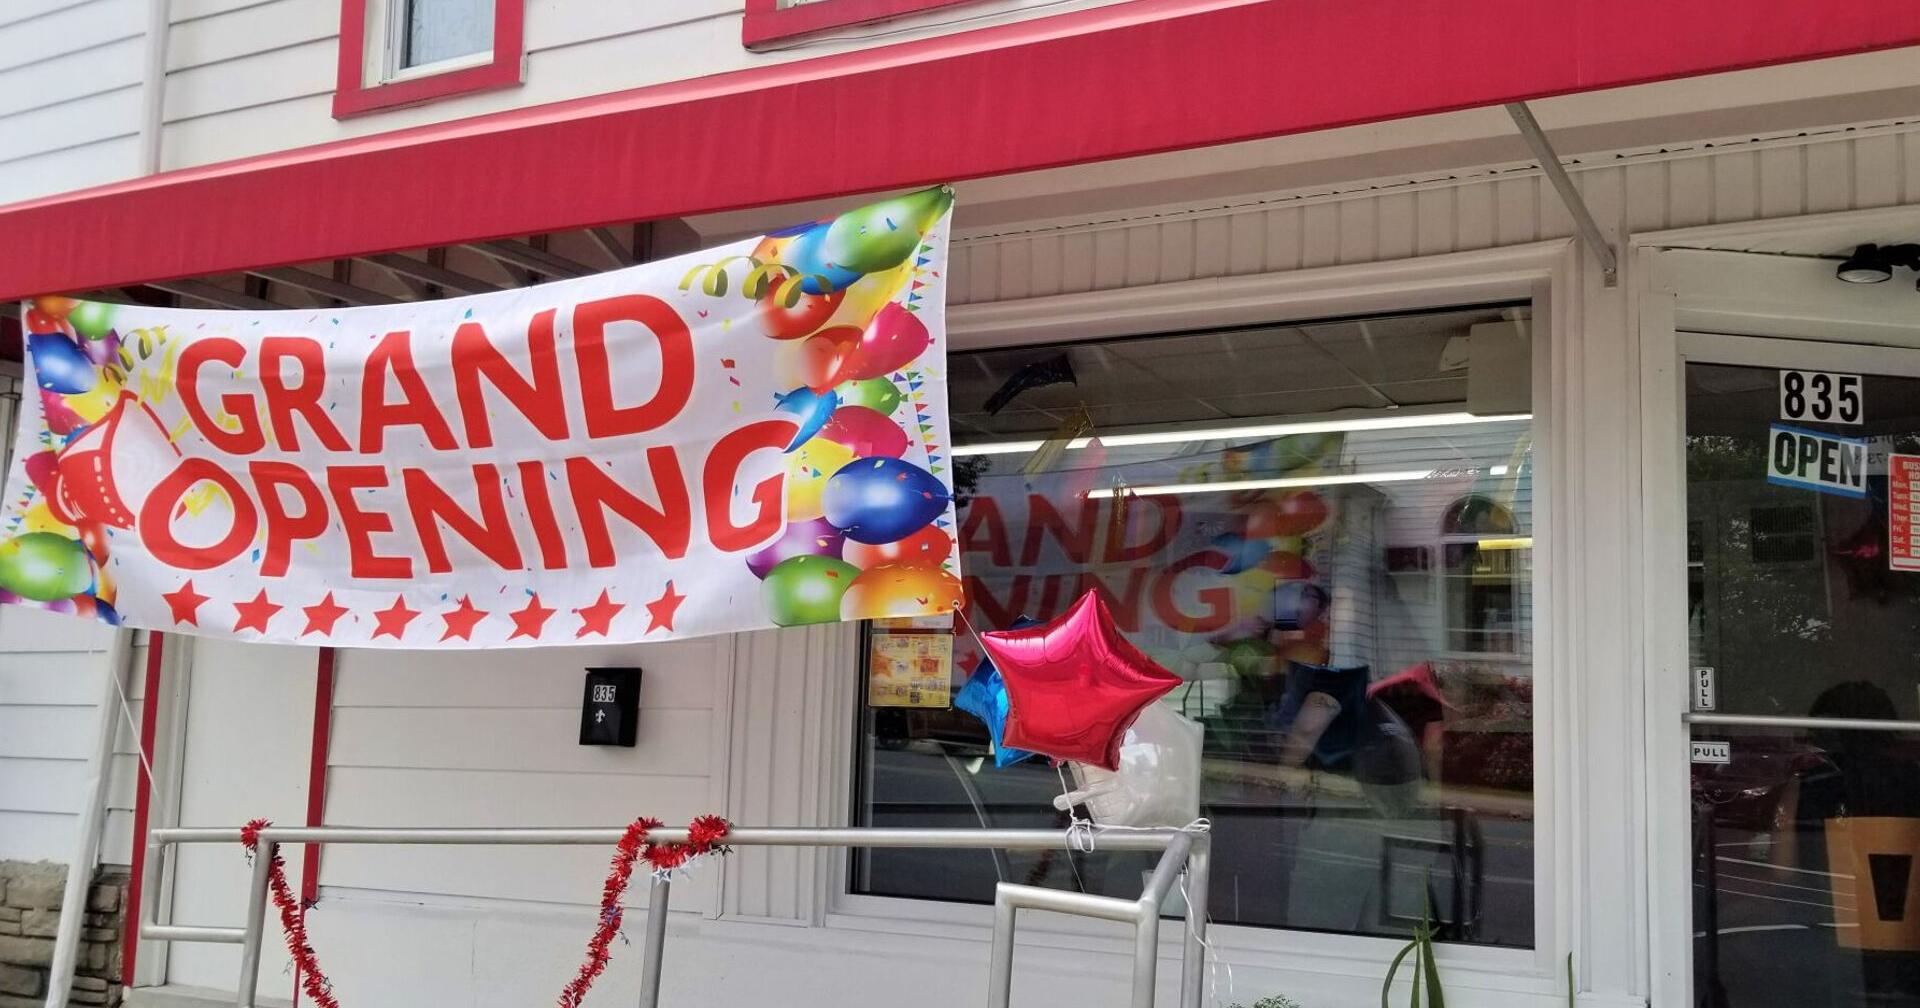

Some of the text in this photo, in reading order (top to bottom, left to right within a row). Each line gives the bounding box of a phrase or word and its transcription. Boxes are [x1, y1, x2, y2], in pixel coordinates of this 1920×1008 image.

[175, 294, 694, 455] GRAND
[1784, 371, 1859, 422] 835
[1773, 431, 1862, 487] OPEN
[139, 419, 801, 579] OPENING
[594, 686, 616, 701] 835
[1700, 670, 1709, 707] PULL
[1694, 747, 1727, 758] PULL
